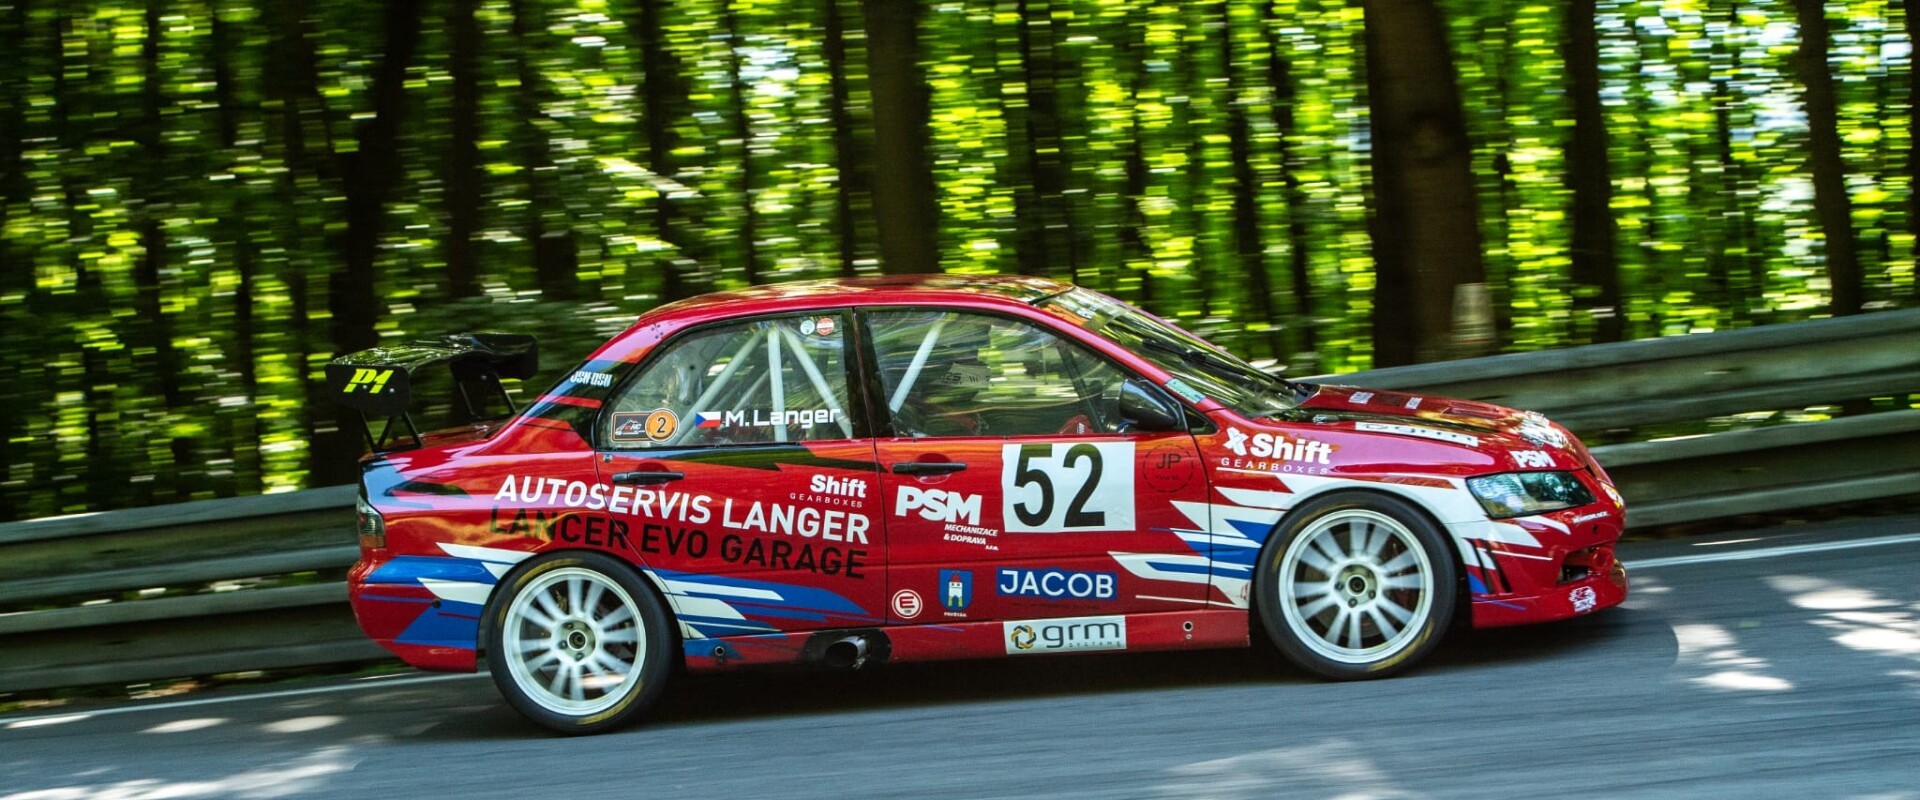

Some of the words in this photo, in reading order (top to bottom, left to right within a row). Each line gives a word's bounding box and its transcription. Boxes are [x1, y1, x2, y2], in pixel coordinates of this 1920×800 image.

[343, 368, 394, 394] P1
[656, 416, 668, 434] 2
[726, 410, 749, 427] M.
[753, 408, 841, 429] Langer
[1156, 452, 1182, 470] JP
[1221, 457, 1329, 475] GEARBOXES
[1509, 449, 1557, 468] PSM
[809, 473, 867, 498] Shift
[1012, 443, 1106, 528] 52
[494, 474, 712, 524] AUTOSERVIS
[722, 498, 870, 545] LANGER
[789, 492, 863, 508] GEARBOXES
[895, 485, 982, 526] PSM
[944, 523, 999, 537] MECHANIZACE
[950, 534, 986, 545] DOPRAVA
[489, 505, 629, 550] LANCER
[641, 523, 709, 558] EVO
[720, 534, 867, 579] GARAGE
[1000, 569, 1114, 599] JACOB
[1042, 622, 1121, 649] grm
